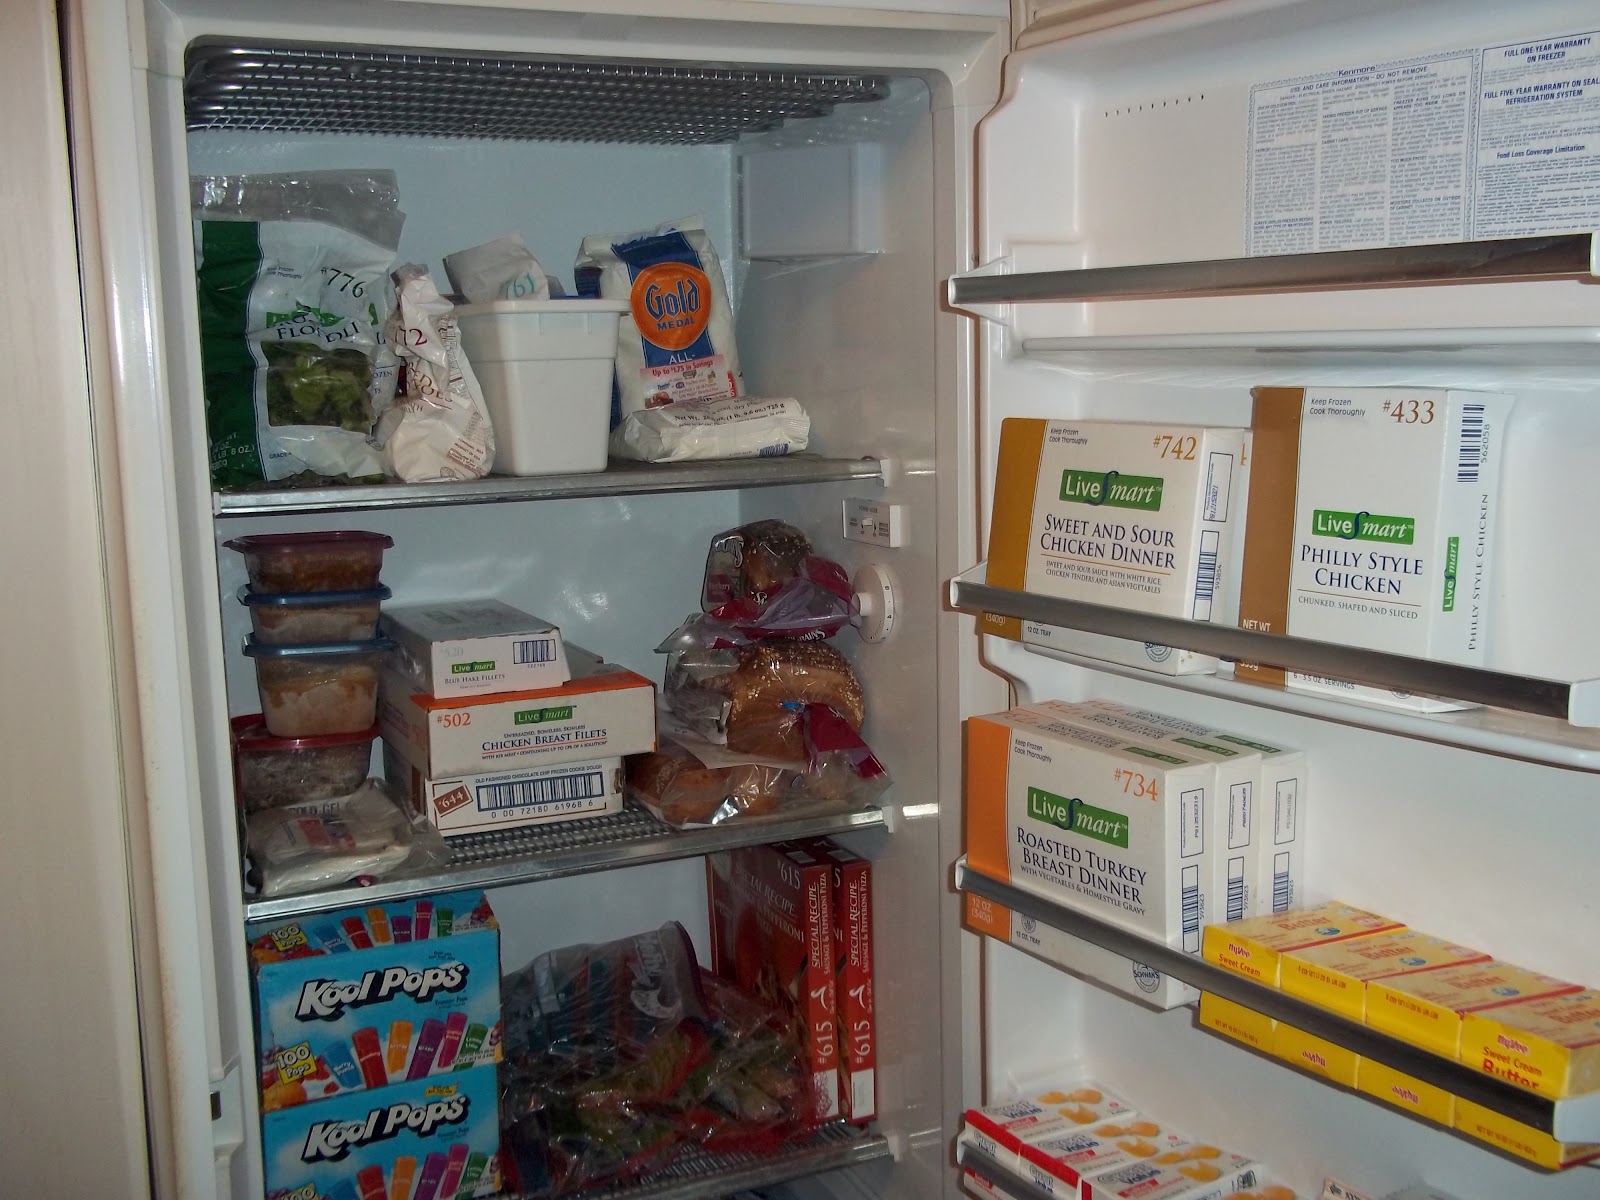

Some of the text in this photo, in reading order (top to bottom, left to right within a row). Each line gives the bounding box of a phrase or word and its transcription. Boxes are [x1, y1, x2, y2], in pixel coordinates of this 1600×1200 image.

[1504, 38, 1591, 57] FULL ONE YEAR WARRANTY
[1538, 51, 1566, 62] FREEZER
[1331, 76, 1369, 87] INFORMATION
[1387, 70, 1400, 78] NOT
[1401, 66, 1427, 75] REMOVE
[1338, 65, 1376, 77] Kenmore
[1500, 89, 1514, 97] FIVE
[1516, 86, 1532, 95] YEAR
[1533, 81, 1570, 93] WARRANTY
[1572, 79, 1581, 87] ON
[1506, 89, 1583, 106] REFRIGERATION SYSTEM
[1512, 150, 1525, 158] Loss
[1526, 148, 1553, 156] Coverage
[1555, 144, 1585, 153] Limitation
[645, 276, 700, 321] Gold
[657, 317, 696, 331] MEDAL
[652, 369, 661, 377] Up
[692, 359, 714, 370] Savings
[669, 352, 695, 365] ALL-
[767, 403, 779, 411] 725
[1311, 398, 1326, 406] Keep
[1382, 399, 1434, 424] #433
[1309, 407, 1365, 418] Cook Thoroughly
[1061, 437, 1088, 445] Thoroughly
[1062, 428, 1079, 436] Frozen
[1153, 434, 1197, 461] #742
[1480, 424, 1490, 463] 562058
[1044, 513, 1176, 548] SWEET AND SOUR
[1040, 533, 1176, 569] CHICKEN DINNER
[1301, 544, 1423, 575] PHILLY STYLE
[1046, 560, 1063, 569] SWEET
[1064, 563, 1075, 571] AND
[1076, 564, 1091, 573] SOUR
[1092, 567, 1109, 577] SAUCE
[1110, 571, 1125, 579] WITH
[1126, 573, 1146, 583] WHITE
[1046, 569, 1161, 594] CHICKEN TENDERS AND ASIAN VEGETABLES
[1315, 567, 1402, 595] CHICKEN
[1468, 494, 1488, 650] PHILLY STYLE CHICKEN
[1338, 601, 1367, 613] SHAPED
[1369, 606, 1387, 615] AND
[1389, 608, 1418, 620] SLICED
[1040, 629, 1051, 637] TRAY
[1242, 618, 1271, 632] NET WT
[1324, 678, 1355, 690] SERVINGS
[437, 712, 471, 728] #502
[481, 729, 607, 751] CHICKEN BREAST FILETS
[1015, 739, 1043, 752] Keep Frozen
[1014, 746, 1052, 763] Cook Thoroughly
[485, 775, 511, 783] FASHIONED
[511, 771, 540, 780] CHOCOLATE
[1114, 767, 1158, 801] #734
[503, 809, 514, 818] 00
[520, 805, 549, 815] 72180
[554, 801, 582, 811] 61968
[1016, 826, 1147, 886] ROASTED TURKEY
[1022, 847, 1142, 904] BREAST DINNER
[1020, 865, 1037, 876] WITH
[1038, 870, 1075, 890] VEGETABLES
[1082, 886, 1121, 907] HOMESTYLE
[1122, 902, 1146, 916] GRAVY
[821, 895, 829, 934] PEPPERONI
[1278, 916, 1334, 932] Butter
[270, 927, 300, 941] 100
[282, 936, 302, 947] Pops
[811, 924, 820, 968] SPECIAL
[851, 923, 860, 967] SPECIAL
[1219, 953, 1261, 977] Sweet Cream
[296, 963, 468, 1019] Kool Pops
[816, 1021, 833, 1064] #615
[854, 1020, 870, 1063] #615
[276, 1044, 311, 1069] 100
[1483, 1047, 1542, 1077] Sweet Cream
[286, 1063, 311, 1078] Pops
[302, 1094, 470, 1161] Kool Pops
